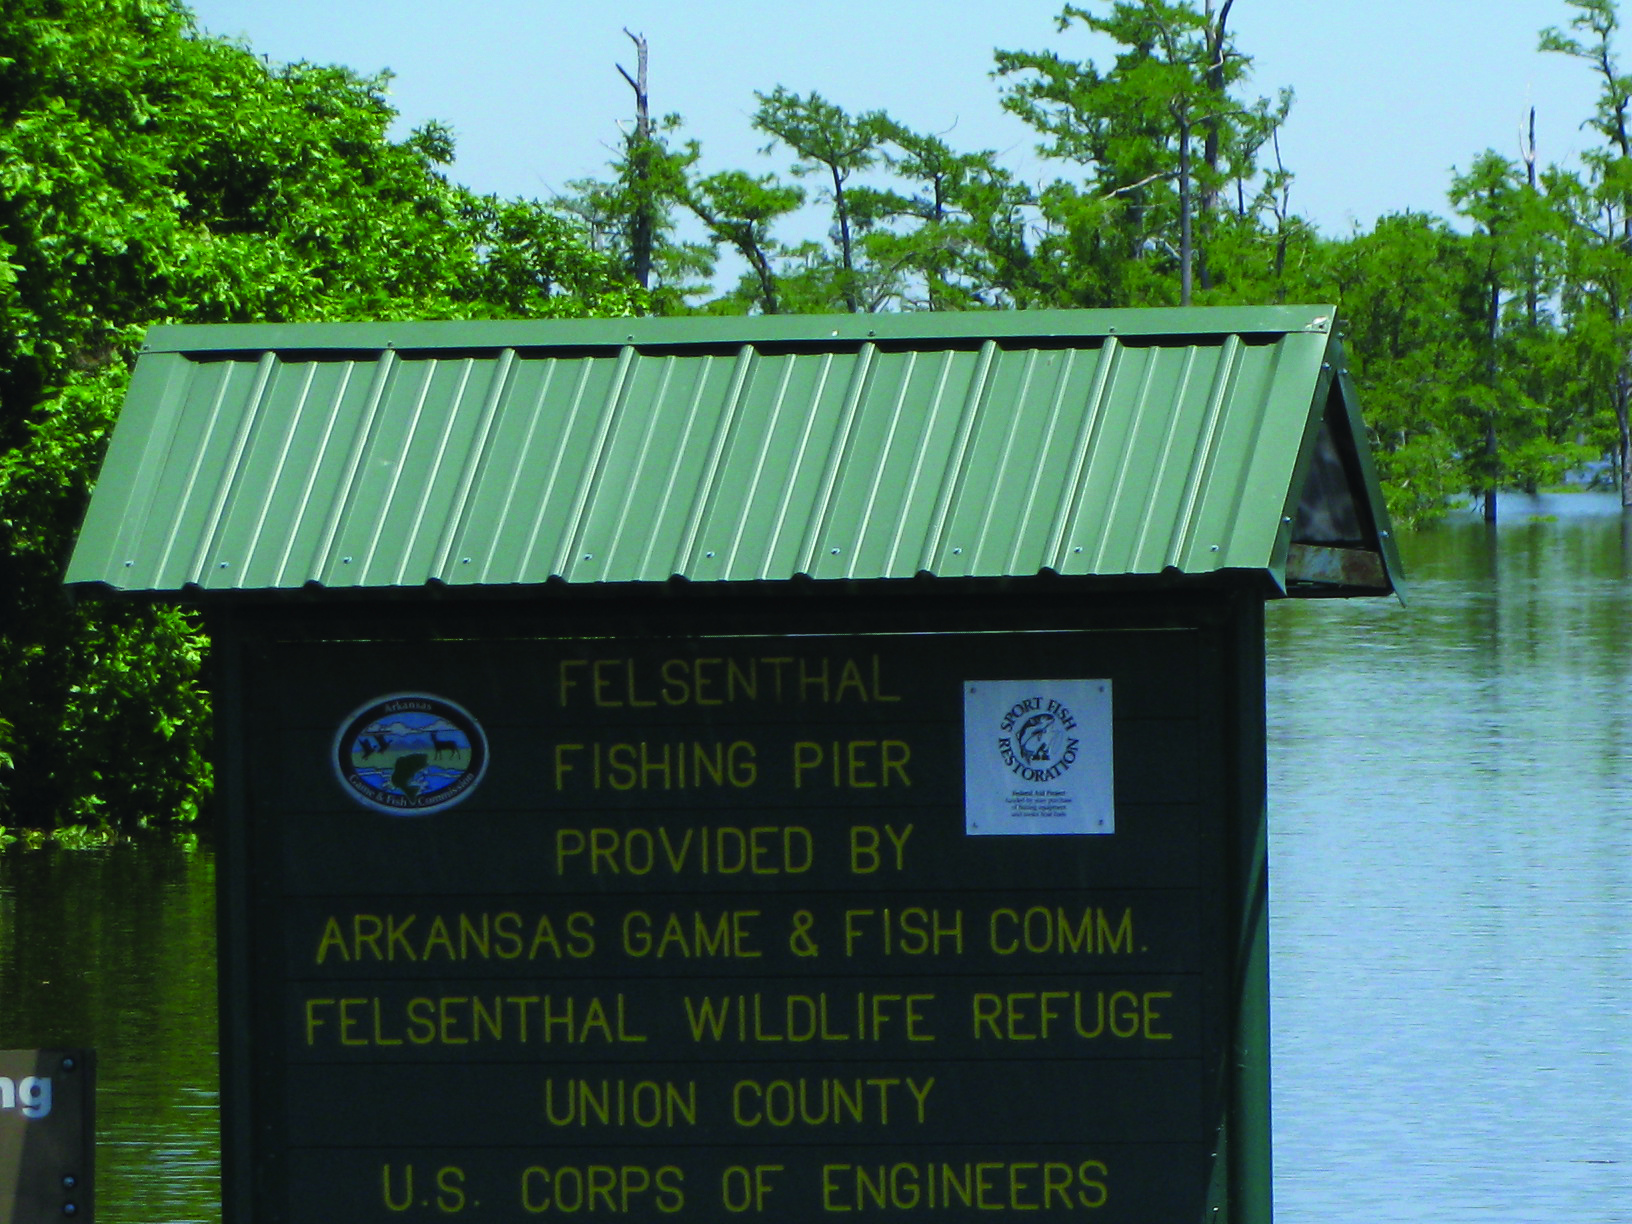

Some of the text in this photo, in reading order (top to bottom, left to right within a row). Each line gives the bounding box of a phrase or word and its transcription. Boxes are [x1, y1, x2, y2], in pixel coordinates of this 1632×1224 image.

[384, 700, 432, 713] Arkansas
[559, 655, 901, 707] FELSENTHAL
[1002, 697, 1078, 732] SPORT FISH
[555, 739, 912, 791] FISHING PIER
[998, 737, 1079, 782] RESTORATION
[386, 795, 407, 806] Fish
[556, 824, 915, 876] PROVIDED BY
[315, 905, 1151, 964] ARKANSAS GAME & FISH COMM.
[305, 990, 1174, 1047] FELSENTHAL WILDLIFE REFUGE
[545, 1077, 937, 1128] UNION COUNTY
[381, 1159, 1109, 1214] U.S. CORPS OF ENGINEERS
